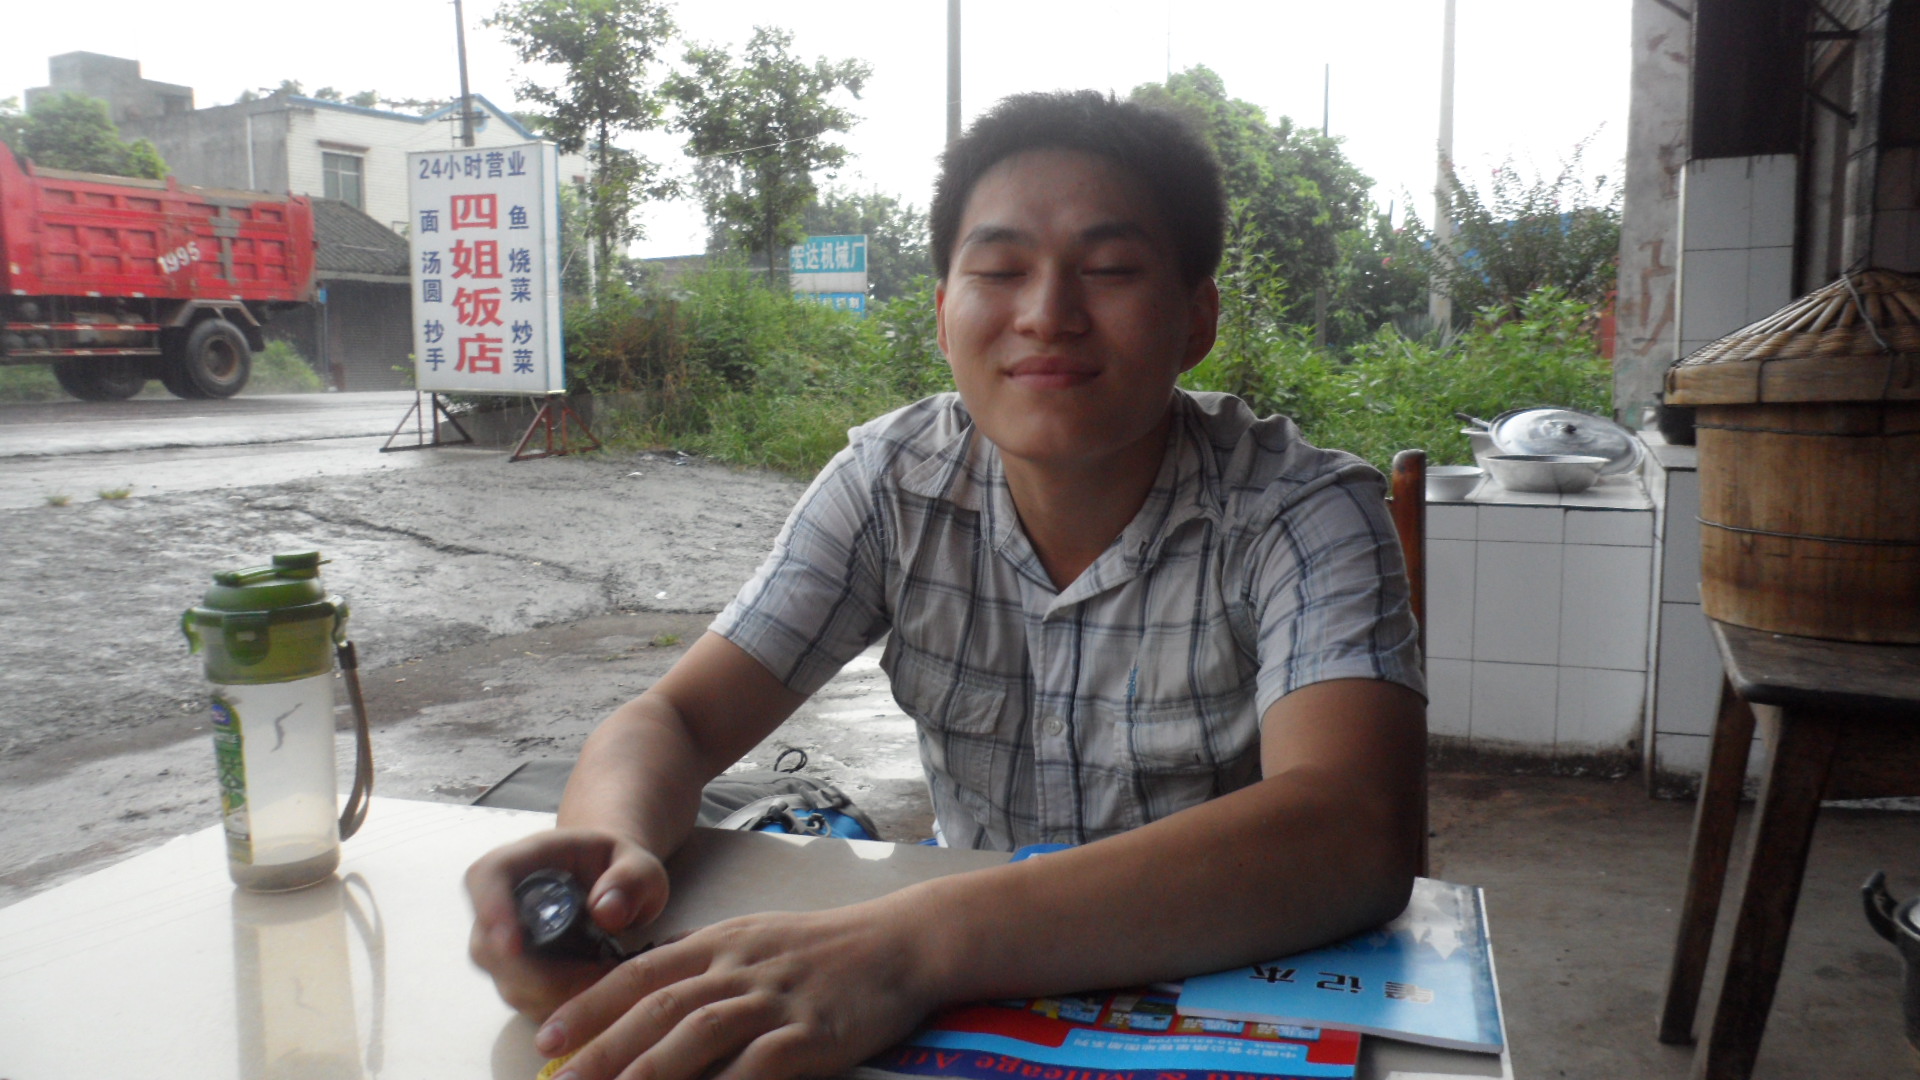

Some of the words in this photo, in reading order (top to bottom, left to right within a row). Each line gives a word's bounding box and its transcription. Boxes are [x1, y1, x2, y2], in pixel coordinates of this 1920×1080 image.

[419, 151, 526, 180] 24小时营业
[419, 209, 439, 233] 面
[508, 205, 529, 230] 鱼
[421, 251, 442, 303] 汤圆
[449, 193, 504, 374] 四姐饭店
[508, 248, 531, 303] 烧菜
[424, 319, 445, 371] 抄手
[511, 320, 534, 374] 炒菜
